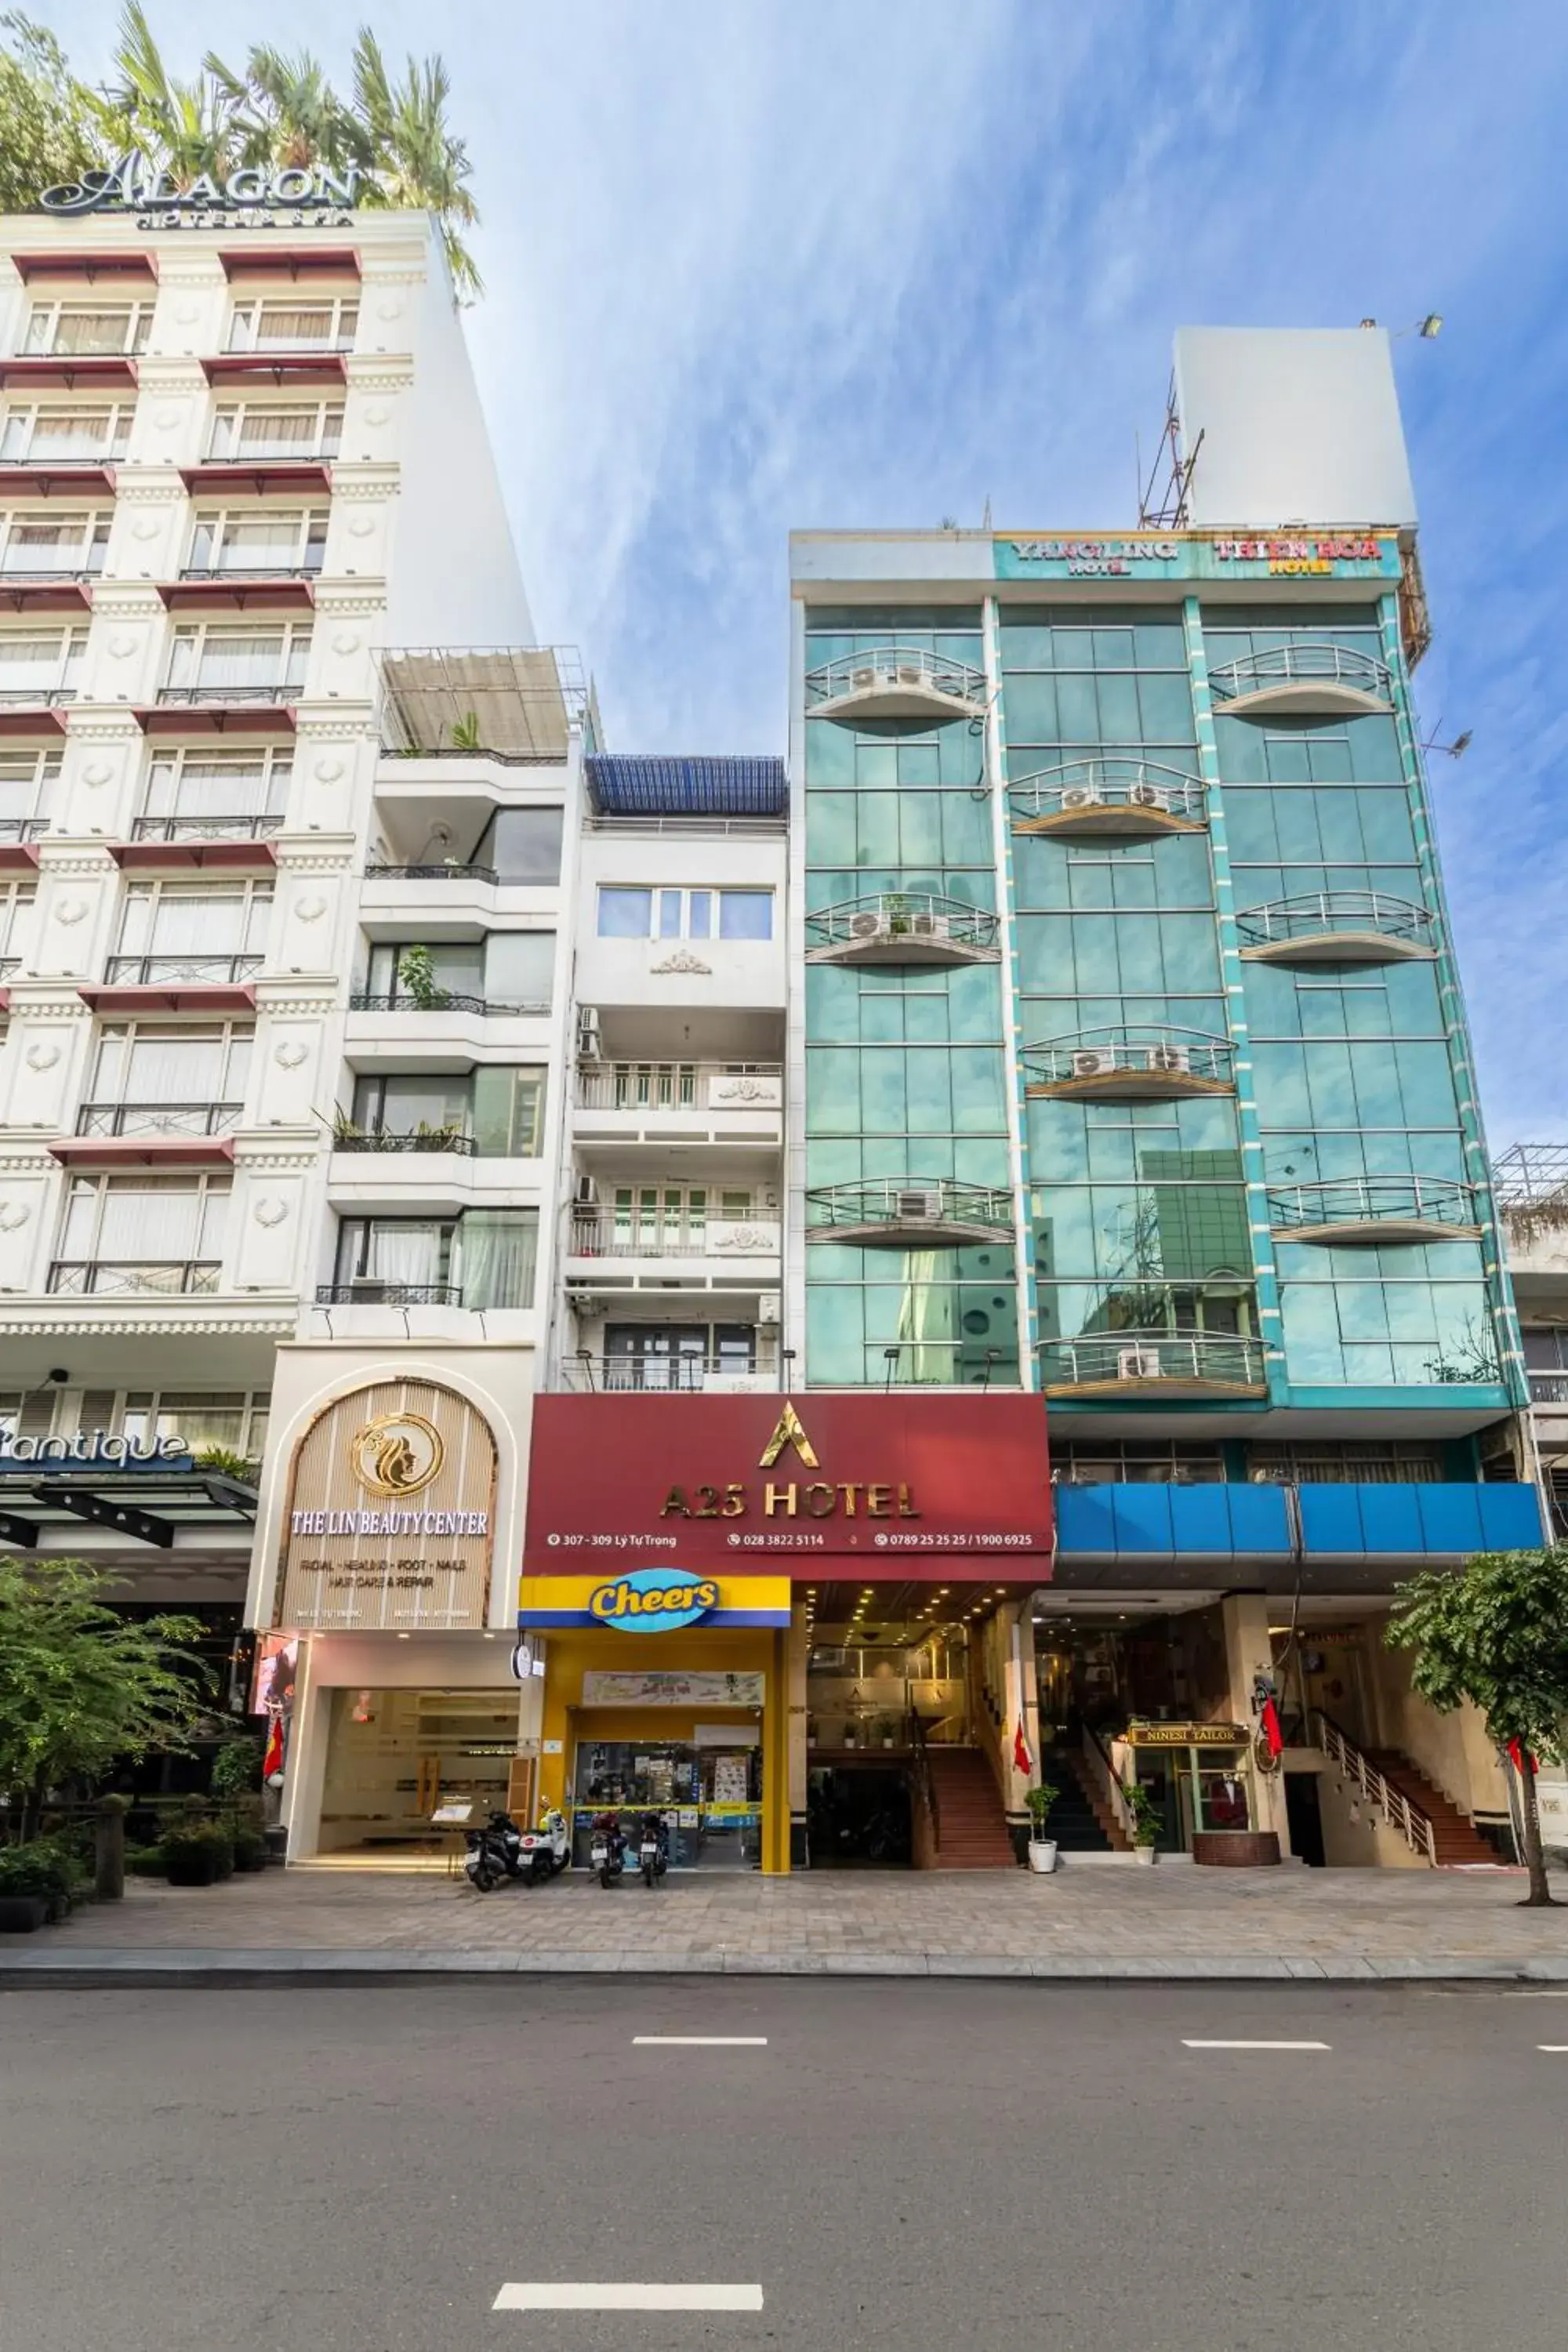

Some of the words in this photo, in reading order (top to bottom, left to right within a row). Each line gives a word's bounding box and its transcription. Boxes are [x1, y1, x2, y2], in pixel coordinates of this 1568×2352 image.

[40, 148, 359, 214] ALAGON
[659, 1483, 746, 1519] A25
[764, 1482, 923, 1518] HOTEL
[292, 1511, 325, 1535] THE
[328, 1511, 356, 1535] LIN
[361, 1511, 424, 1535] BEAUTY
[424, 1511, 488, 1535] CENTER
[743, 1534, 764, 1545] 028
[767, 1534, 793, 1545] 3822
[797, 1534, 824, 1545] 5114
[890, 1534, 918, 1546] 0789
[920, 1534, 934, 1546] 25
[935, 1534, 949, 1546] 25
[952, 1534, 966, 1546] 25
[975, 1534, 1003, 1546] 1900
[1004, 1534, 1033, 1546] 6925
[397, 1559, 426, 1571] FOOT
[397, 1577, 434, 1589] REPAIR
[590, 1581, 717, 1618] Cheers
[1193, 1730, 1236, 1740] TAILOR
